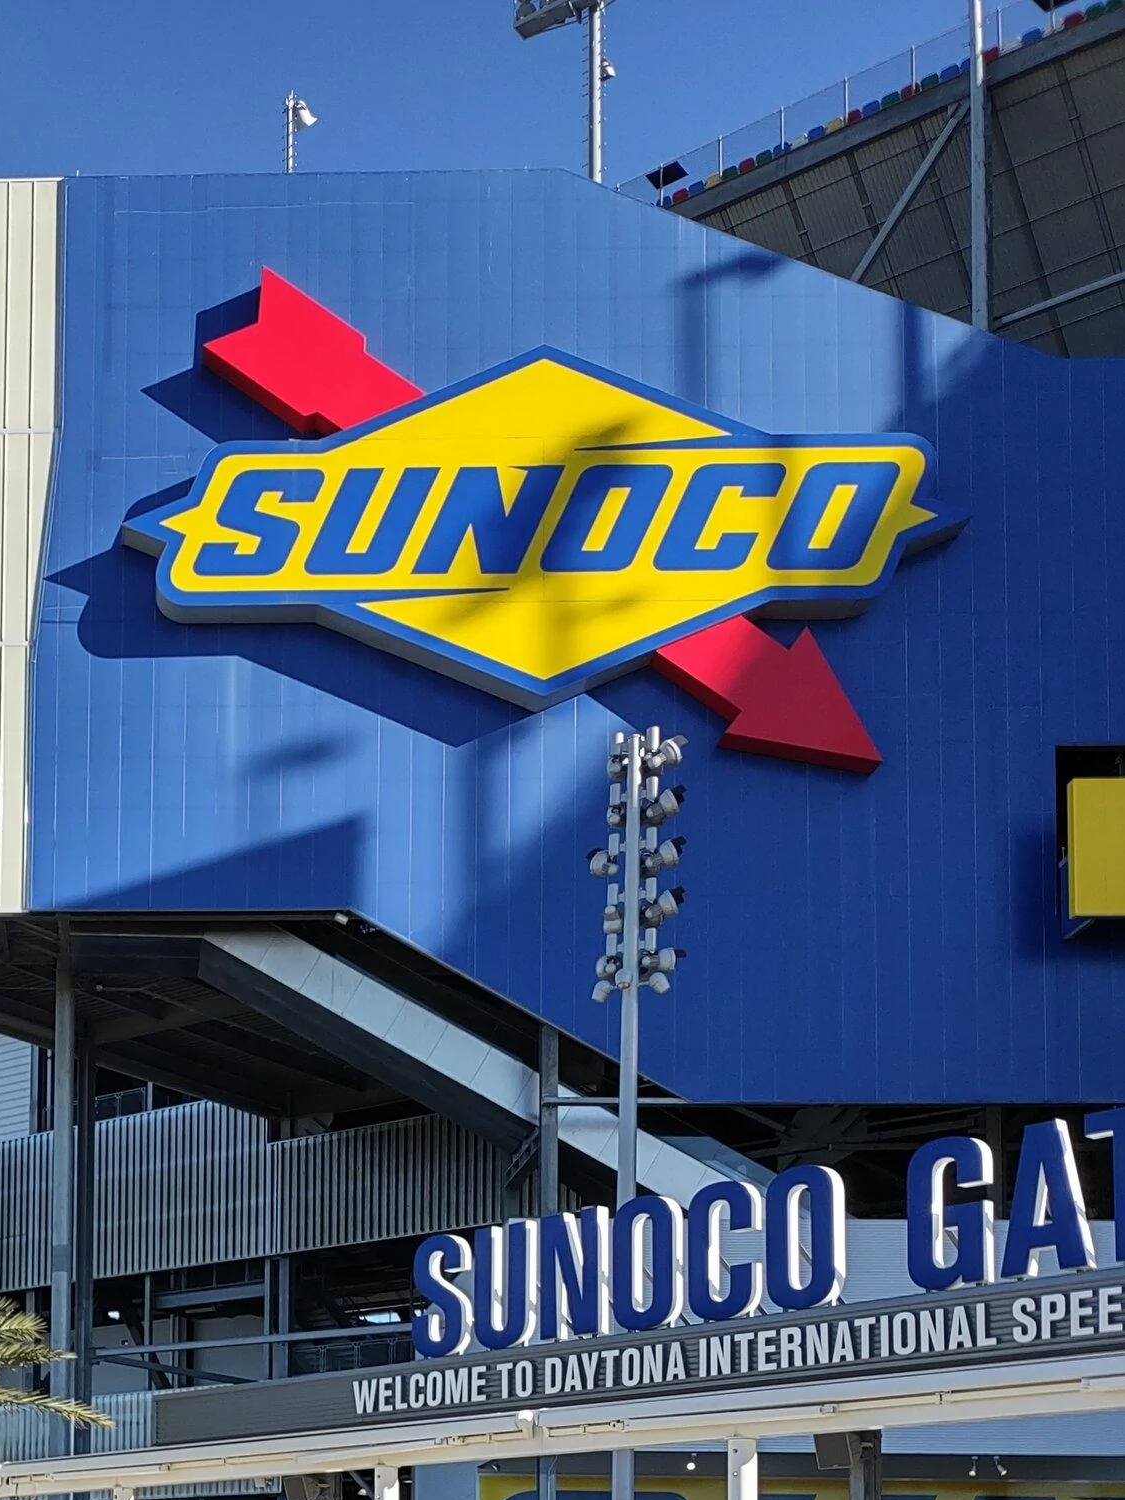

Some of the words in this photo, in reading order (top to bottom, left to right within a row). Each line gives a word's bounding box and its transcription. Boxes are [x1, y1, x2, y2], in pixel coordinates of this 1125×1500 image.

[192, 461, 898, 576] SUNOCO
[411, 1164, 847, 1358] SUNOCO
[352, 1364, 487, 1414] WELCOME
[495, 1360, 534, 1399] TO
[544, 1341, 687, 1395] DAYTONA
[698, 1302, 997, 1378] INTERNATIONAL
[1012, 1285, 1123, 1343] SPEE
